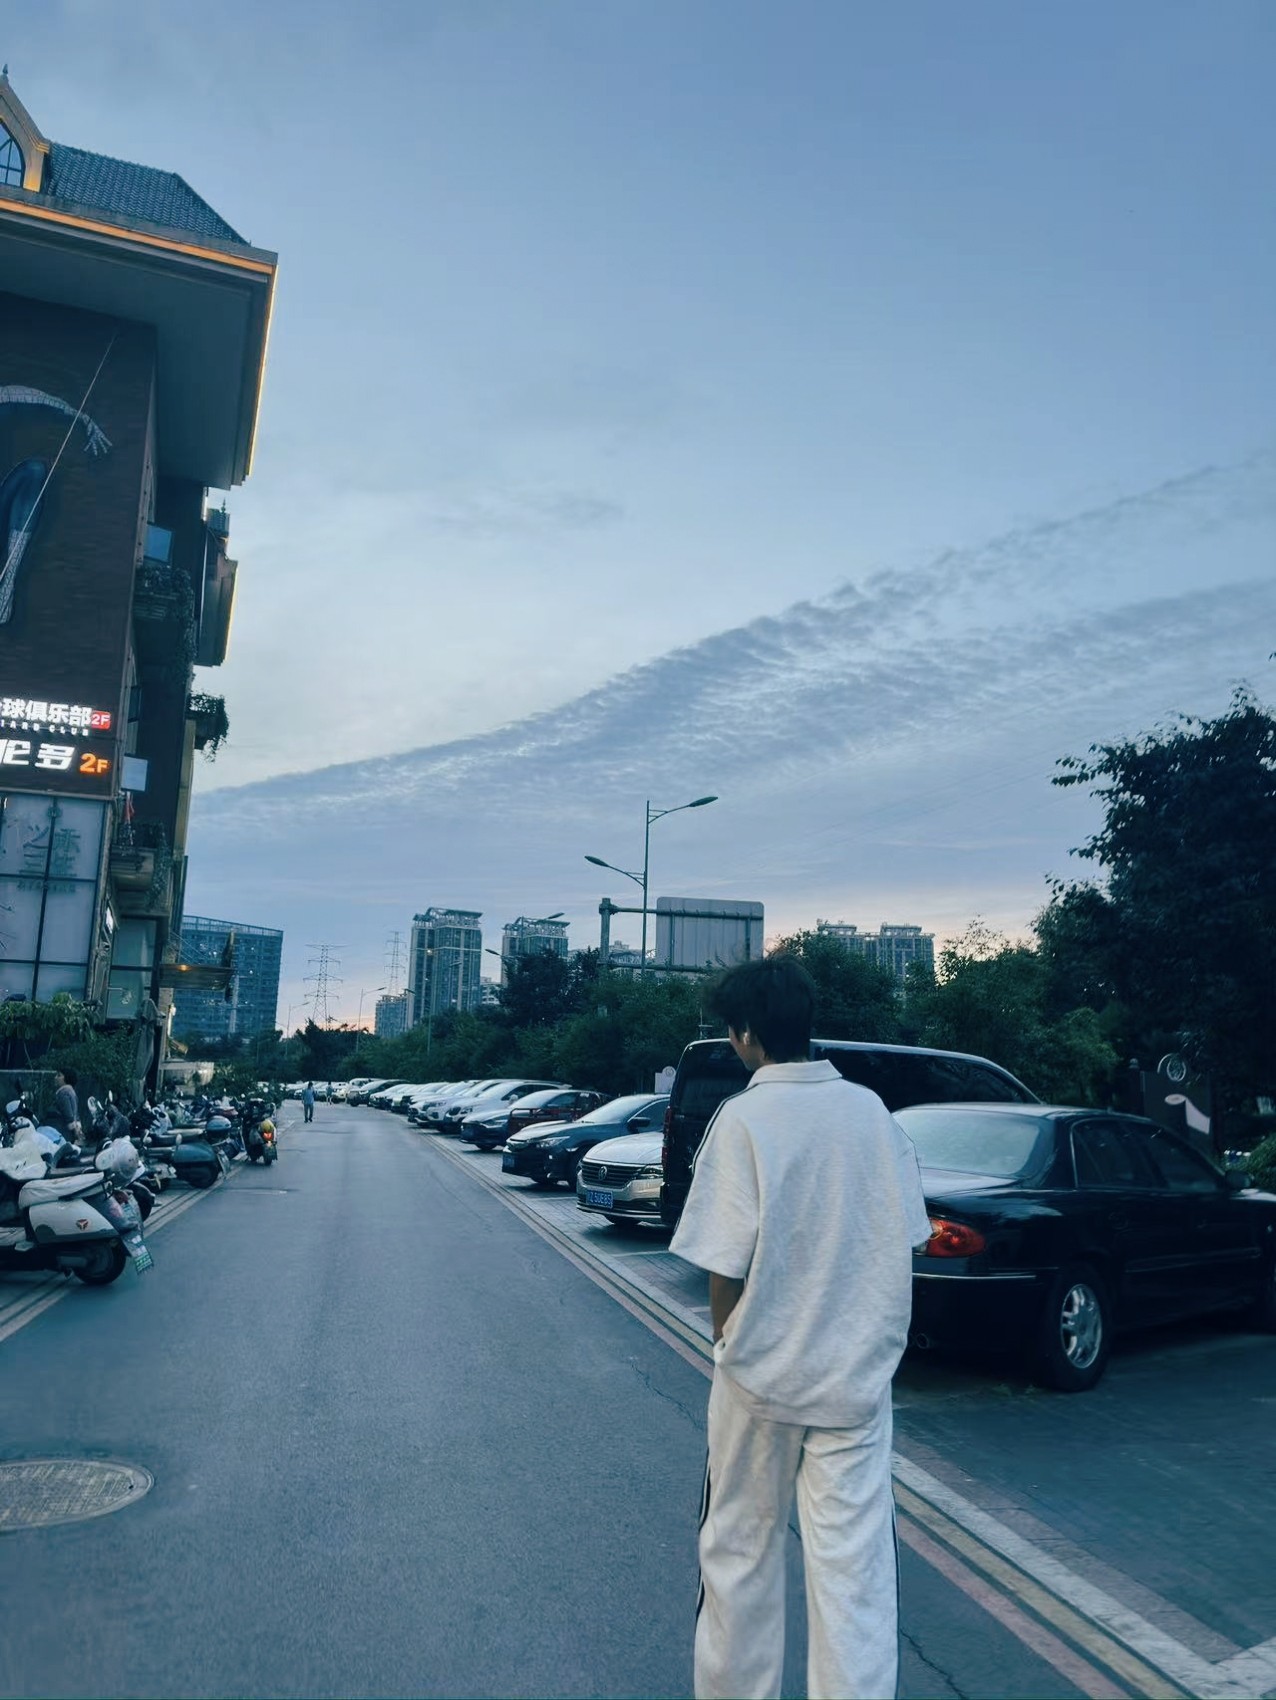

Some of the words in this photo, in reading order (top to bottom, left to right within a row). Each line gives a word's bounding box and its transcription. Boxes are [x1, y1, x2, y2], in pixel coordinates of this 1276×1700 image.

[0, 698, 92, 727] 球俱乐部
[91, 713, 110, 727] 2F
[80, 753, 108, 773] 2F
